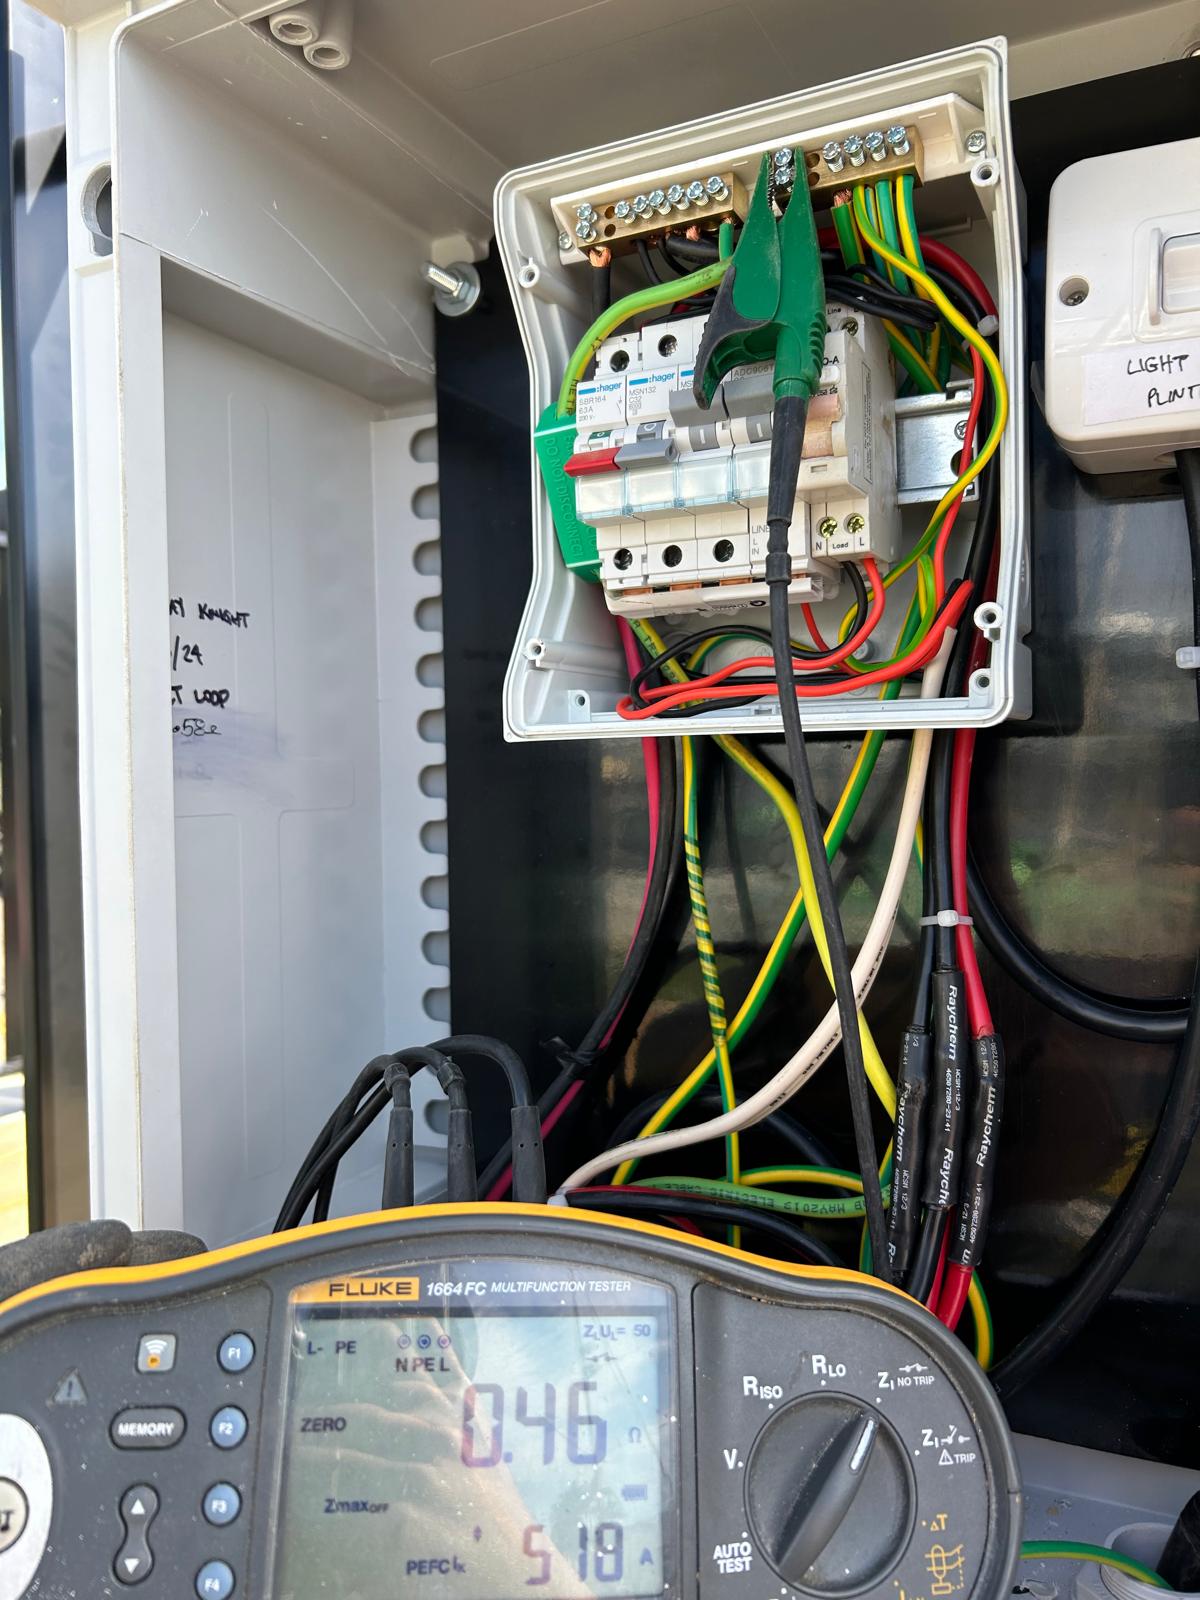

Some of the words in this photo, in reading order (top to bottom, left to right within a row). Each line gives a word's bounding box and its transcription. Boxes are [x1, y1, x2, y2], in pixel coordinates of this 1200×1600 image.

[1127, 354, 1190, 375] LIGHT
[816, 542, 823, 551] N
[832, 542, 849, 550] Load
[859, 537, 865, 546] L
[193, 689, 230, 709] LOOP
[946, 984, 958, 1061] Raychem
[975, 1085, 996, 1167] Raychem
[328, 1280, 413, 1297] FLUKE
[490, 1281, 586, 1294] MULTIFUNCTION
[588, 1280, 632, 1293] TESTER
[633, 1323, 651, 1338] 50
[228, 1348, 242, 1359] F1
[335, 1340, 357, 1354] PE
[897, 1376, 912, 1387] NO
[912, 1375, 935, 1386] TRIP
[118, 1423, 175, 1436] MEMORY
[218, 1423, 233, 1435] F2
[300, 1417, 347, 1434] ZERO
[460, 1380, 608, 1468] 0.46
[953, 1453, 976, 1464] TRIP
[211, 1501, 227, 1513] F3
[639, 1549, 654, 1565] A
[713, 1542, 752, 1560] AUTO
[406, 1559, 450, 1575] PEFC
[717, 1557, 752, 1574] TEST
[204, 1579, 220, 1592] F4
